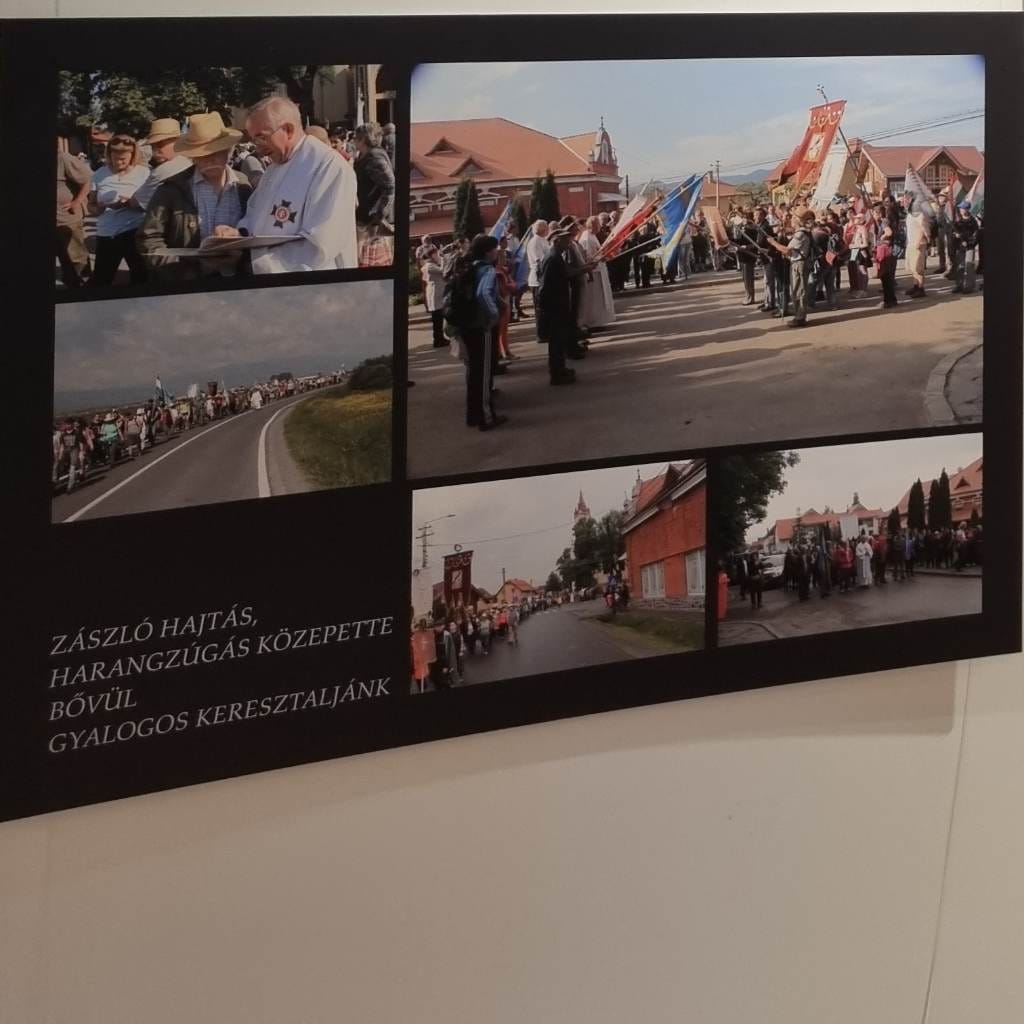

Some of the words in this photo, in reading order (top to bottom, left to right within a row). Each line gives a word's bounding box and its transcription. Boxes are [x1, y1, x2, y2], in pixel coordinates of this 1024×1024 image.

[49, 635, 250, 689] HARANGZÚGÁS
[256, 616, 394, 655] KÖZEPETTE
[50, 614, 154, 656] ZÁSZLÓ
[159, 603, 258, 638] HAJTÁS,
[48, 711, 189, 753] GYALOGOS
[195, 677, 392, 728] KERESZTALJÁNK
[49, 686, 137, 721] BŐVÜL
